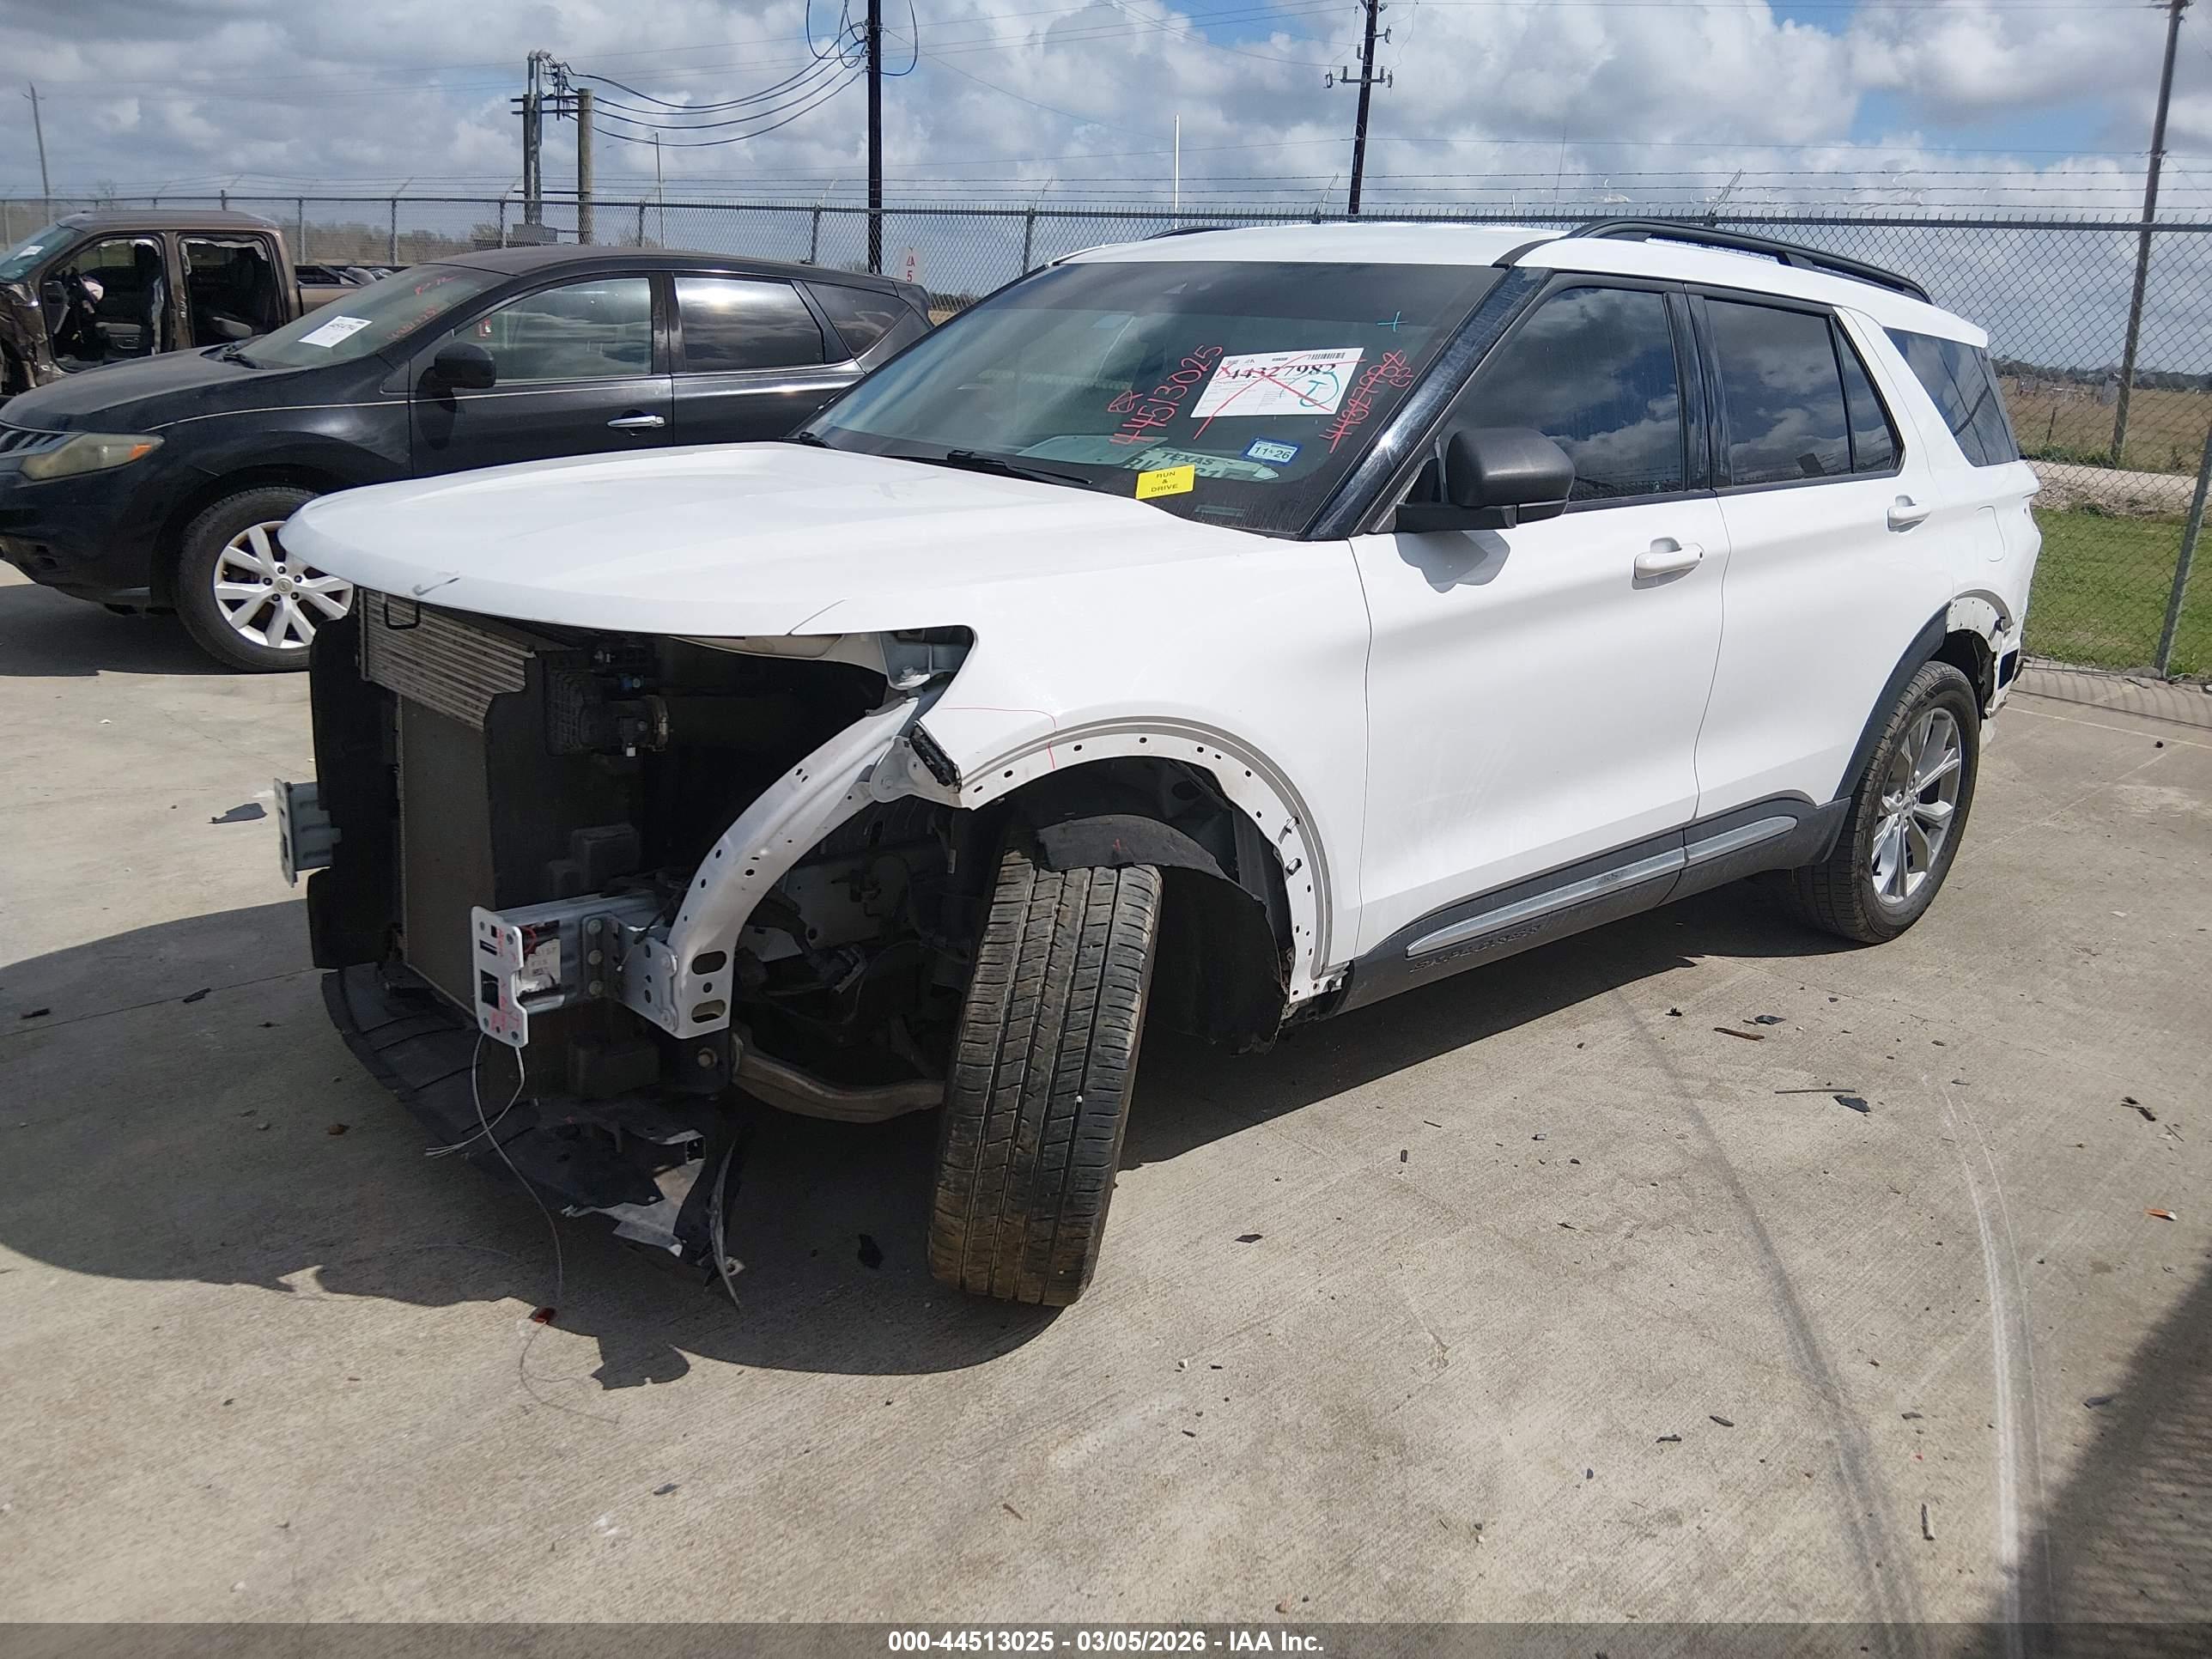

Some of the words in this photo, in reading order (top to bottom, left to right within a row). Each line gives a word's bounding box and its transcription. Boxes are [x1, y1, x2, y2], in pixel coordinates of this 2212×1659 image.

[907, 270, 914, 283] 5
[1229, 362, 1336, 380] 44327982
[1108, 344, 1223, 445] 44513025
[1161, 452, 1216, 465] TEXAS
[1151, 483, 1179, 493] DRIVE
